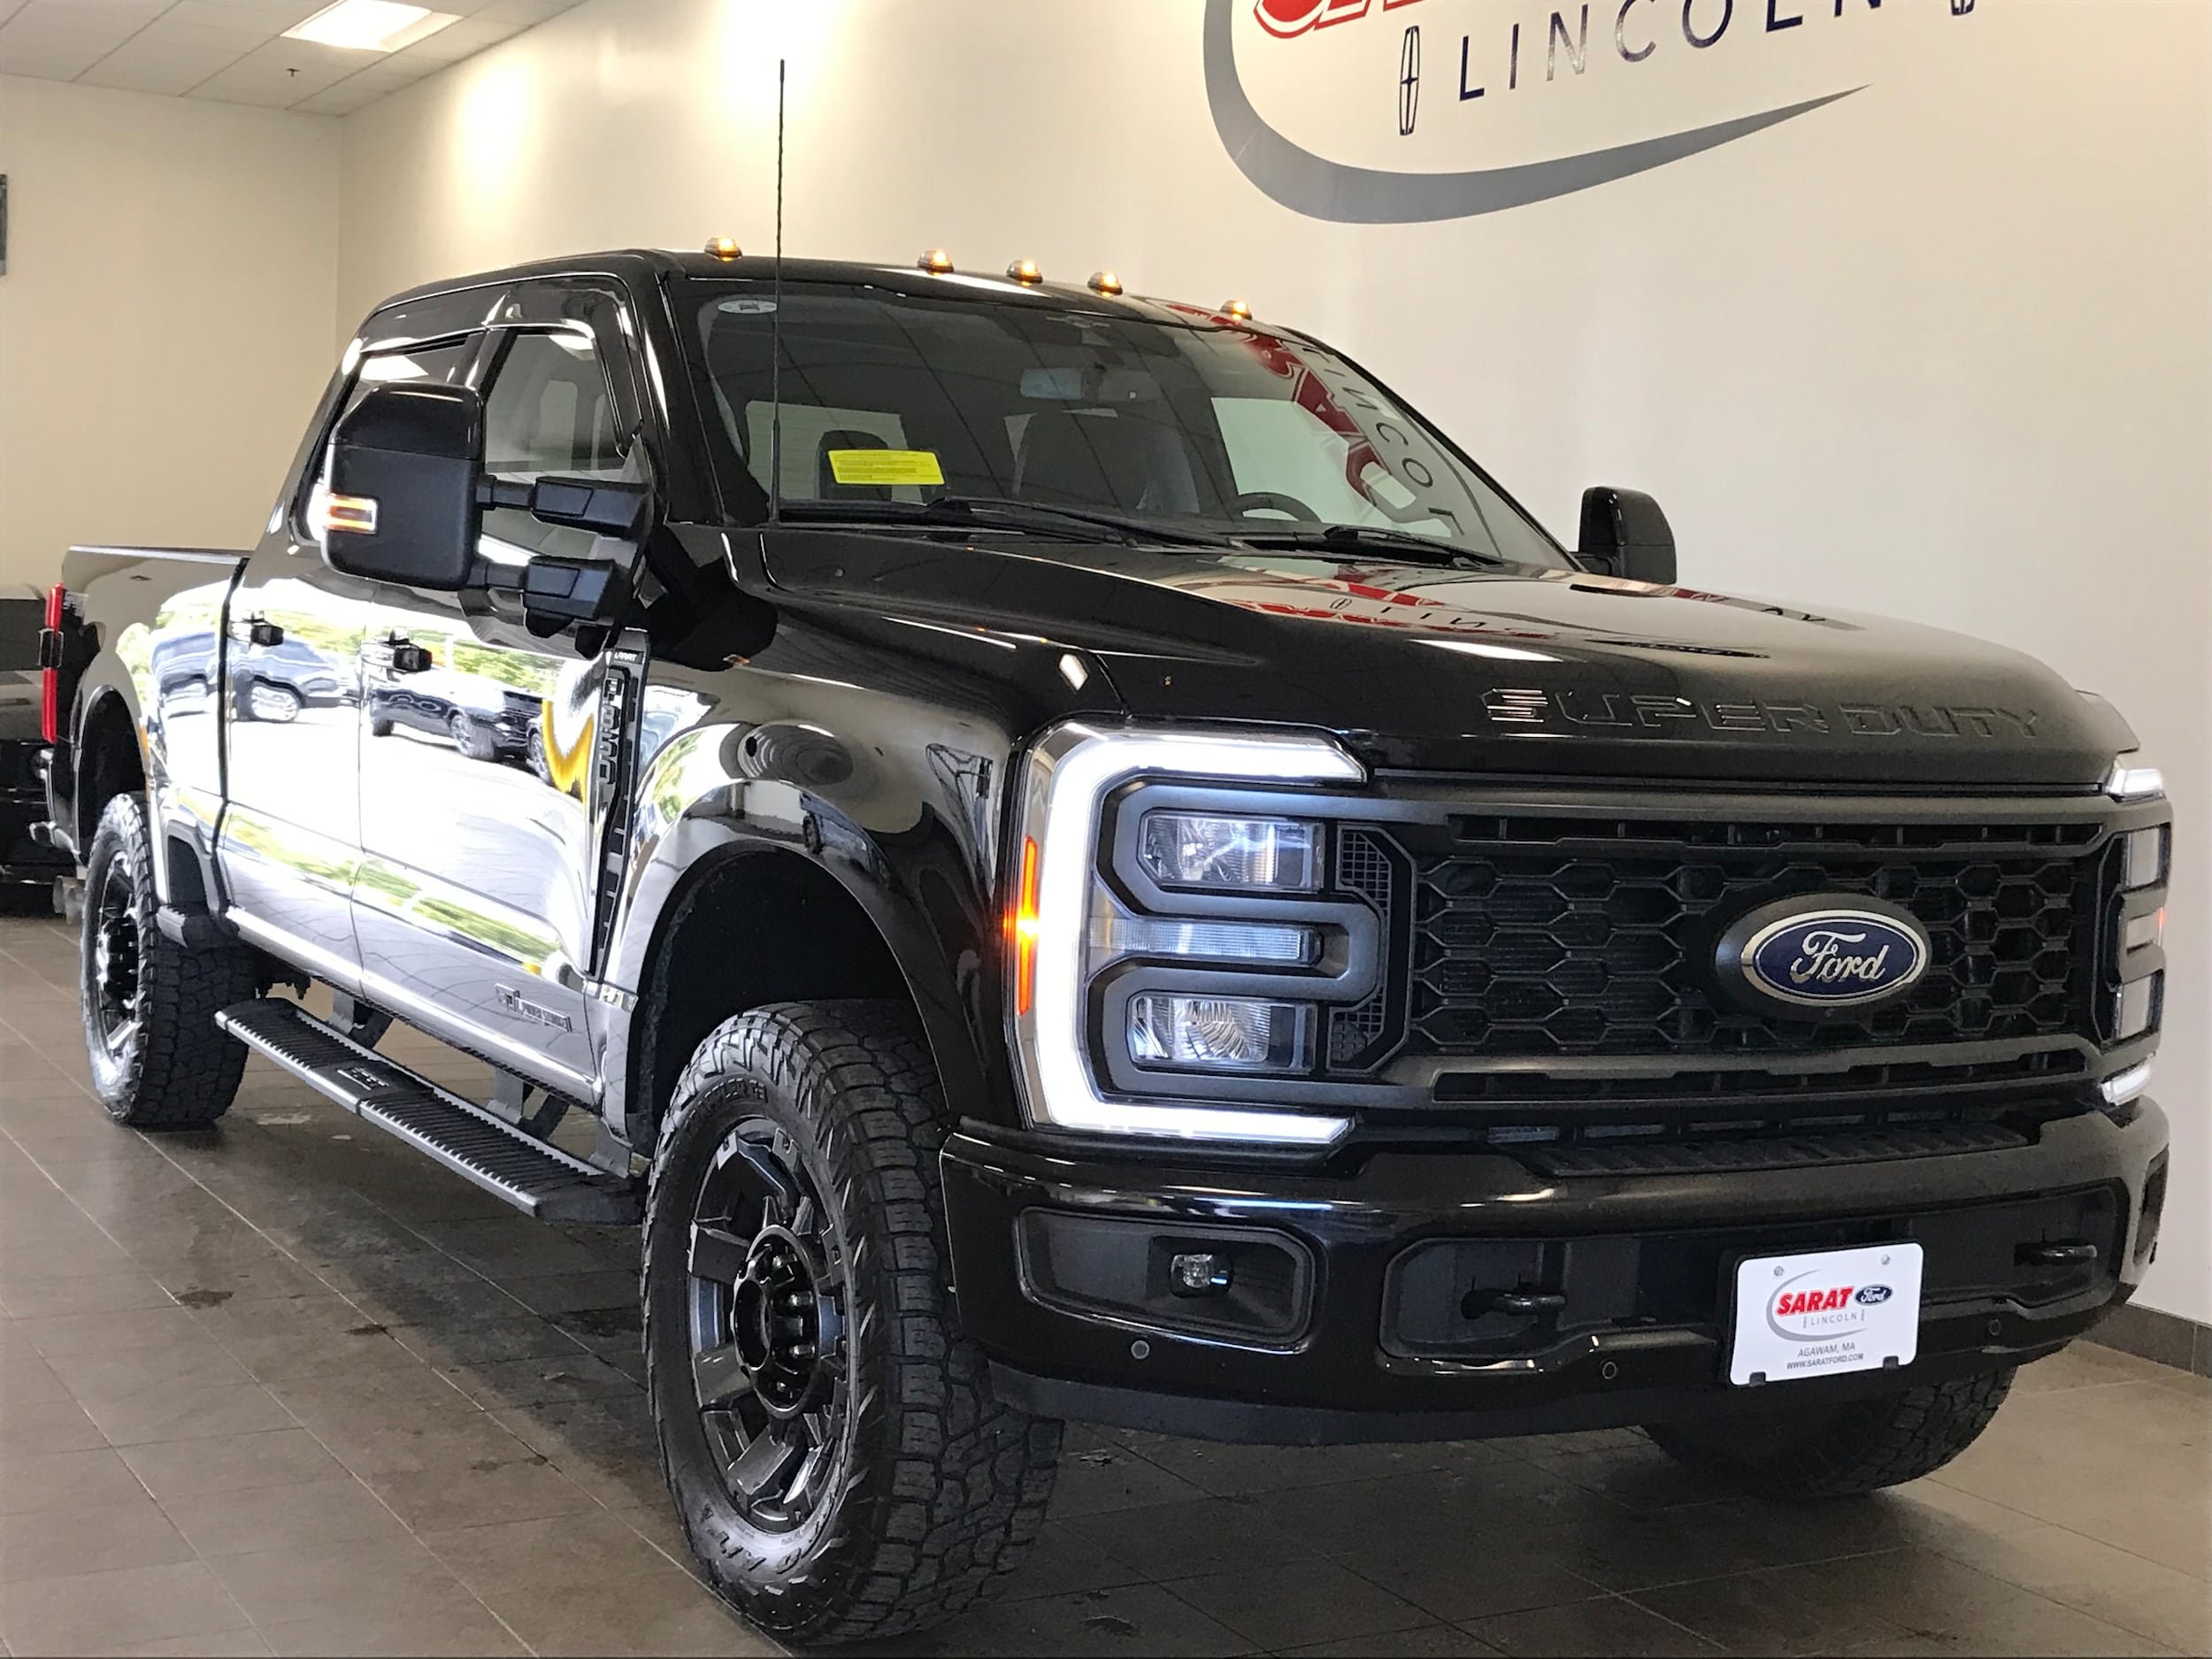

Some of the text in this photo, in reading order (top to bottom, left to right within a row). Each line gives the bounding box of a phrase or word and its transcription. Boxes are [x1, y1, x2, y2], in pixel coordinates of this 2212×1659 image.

[1479, 687, 2037, 740] SUPER DUTY
[1790, 930, 1890, 984] Ford
[1776, 1286, 1886, 1317] SARAT Ford
[1810, 1312, 1857, 1325] LINCOLN
[1797, 1341, 1855, 1356] AGAWAM, MA
[1786, 1353, 1864, 1370] WWW.SARATFORD.COM
